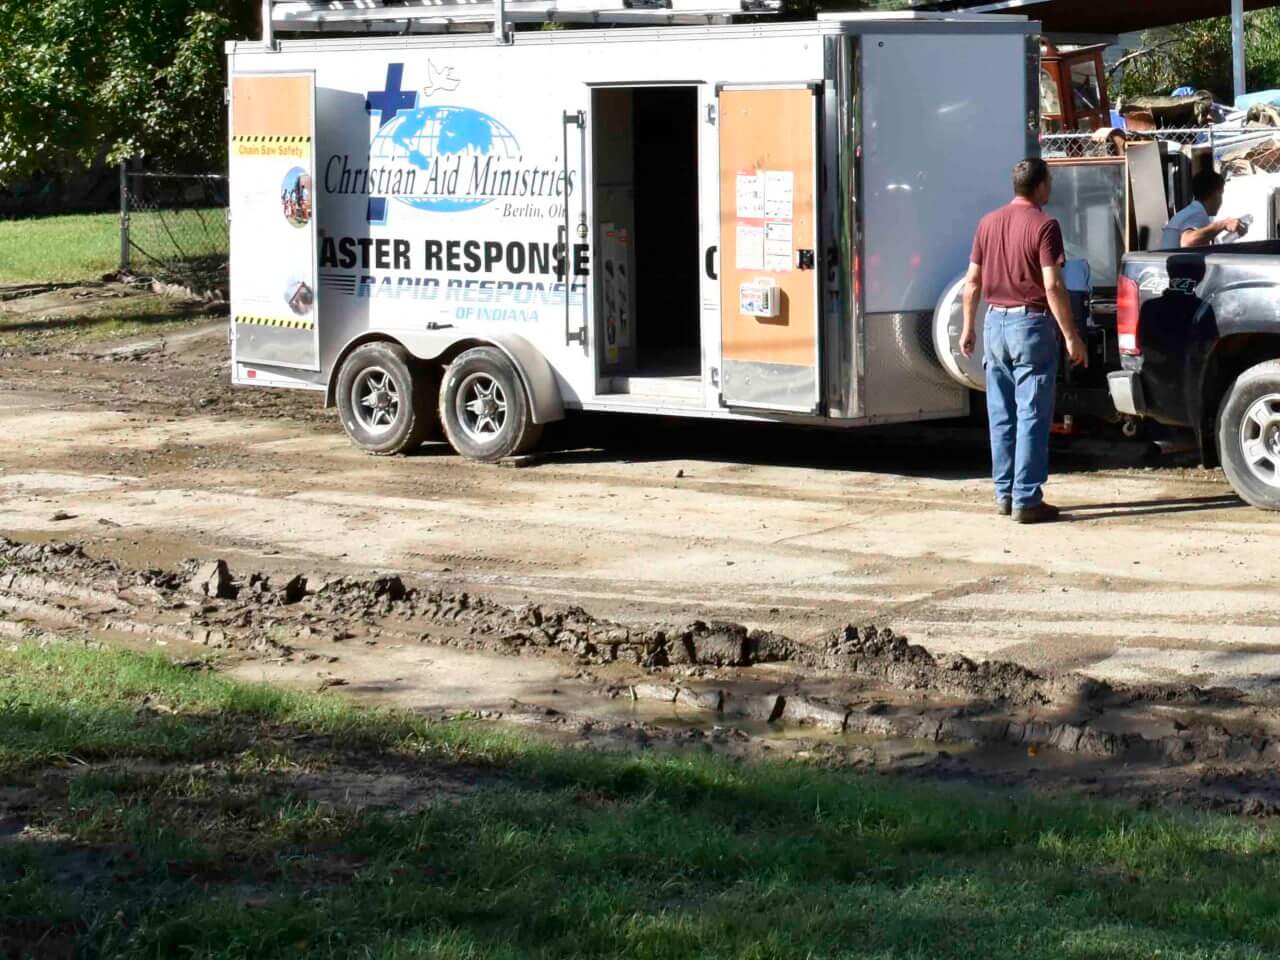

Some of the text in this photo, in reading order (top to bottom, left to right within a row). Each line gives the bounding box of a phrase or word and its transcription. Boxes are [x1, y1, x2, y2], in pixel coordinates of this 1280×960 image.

[261, 145, 276, 155] Saw
[278, 145, 303, 158] Safety
[324, 154, 576, 197] Christian Aid Ministries
[503, 203, 544, 219] Berlin,
[425, 239, 590, 277] RESPONSE
[357, 275, 587, 306] RAPID RESPONSE
[455, 306, 539, 323] OF INDIANA
